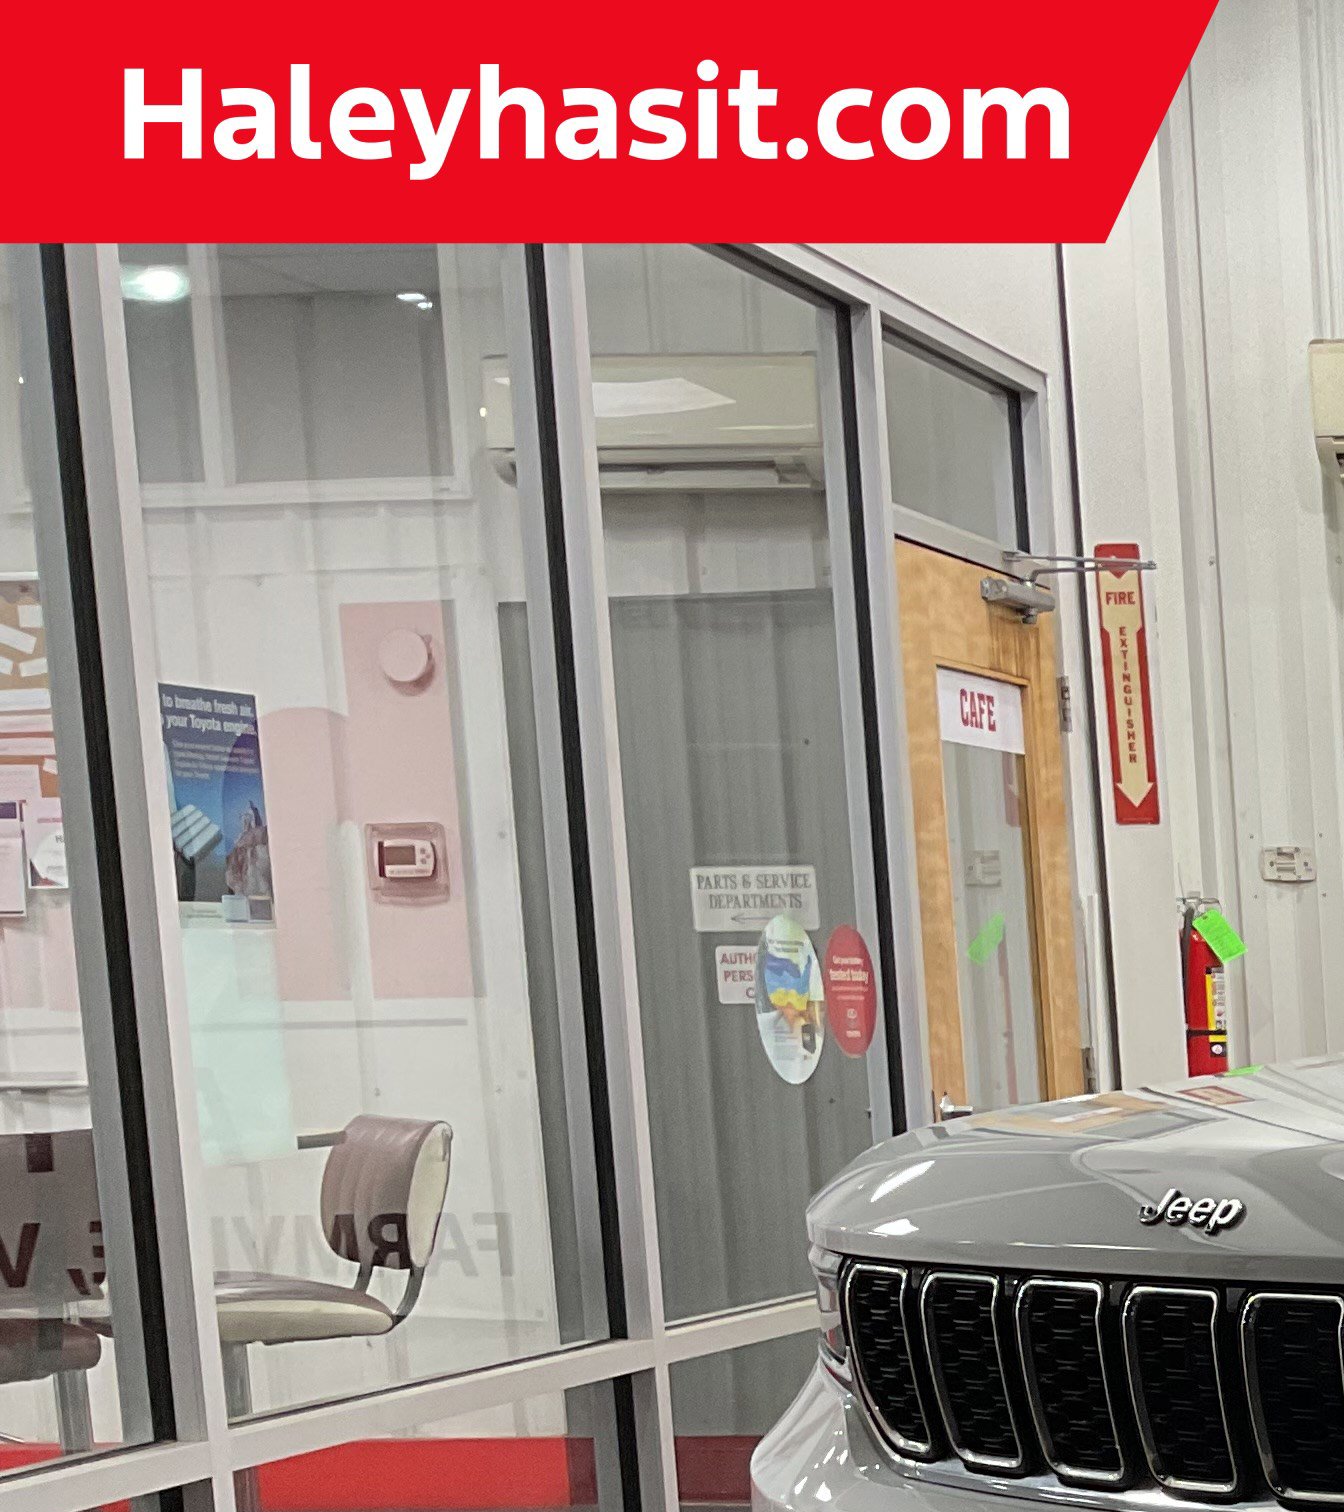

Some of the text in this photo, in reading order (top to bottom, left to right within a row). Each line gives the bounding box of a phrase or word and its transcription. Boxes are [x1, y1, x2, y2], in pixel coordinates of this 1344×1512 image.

[1105, 591, 1137, 606] FIRE
[960, 688, 997, 732] CAFE
[1118, 626, 1138, 764] EXTINGUISHER
[696, 874, 738, 890] PARTS
[756, 872, 812, 890] SERVICE
[709, 893, 803, 910] DEPARTMENTS
[1138, 1187, 1248, 1237] Jeep
